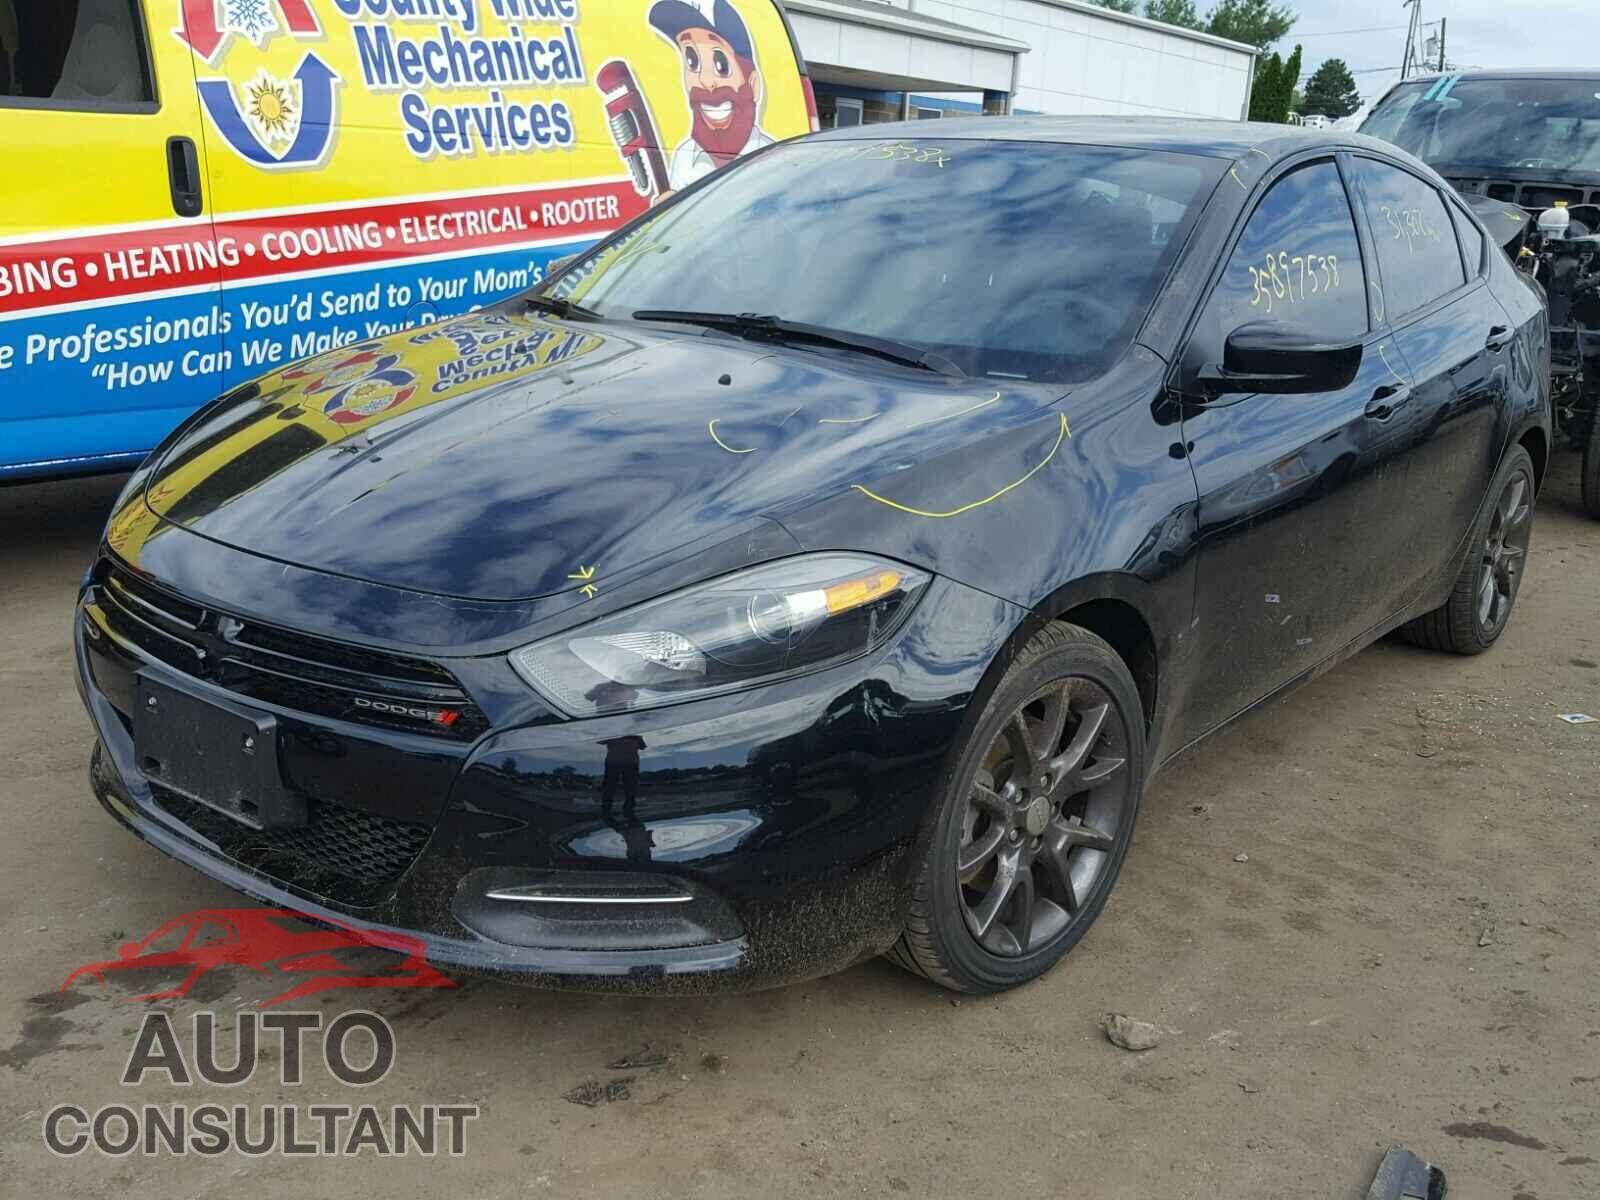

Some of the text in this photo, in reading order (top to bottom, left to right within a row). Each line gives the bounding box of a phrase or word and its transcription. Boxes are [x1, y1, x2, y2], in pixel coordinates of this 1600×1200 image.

[353, 25, 583, 85] Mechanical
[401, 91, 572, 154] Services
[103, 237, 240, 282] HEATING
[261, 221, 383, 261] COOLING
[400, 206, 528, 245] ELECTRICAL
[541, 195, 620, 227] ROOTER
[25, 305, 232, 365] Professionals
[240, 292, 313, 330] You’d
[320, 283, 381, 318] Send
[386, 284, 411, 309] to
[418, 276, 468, 302] Your
[473, 260, 542, 295] Mom’s
[181, 350, 233, 377] Can
[241, 338, 282, 367] We
[290, 326, 358, 359] Make
[354, 697, 443, 721] DODGE
